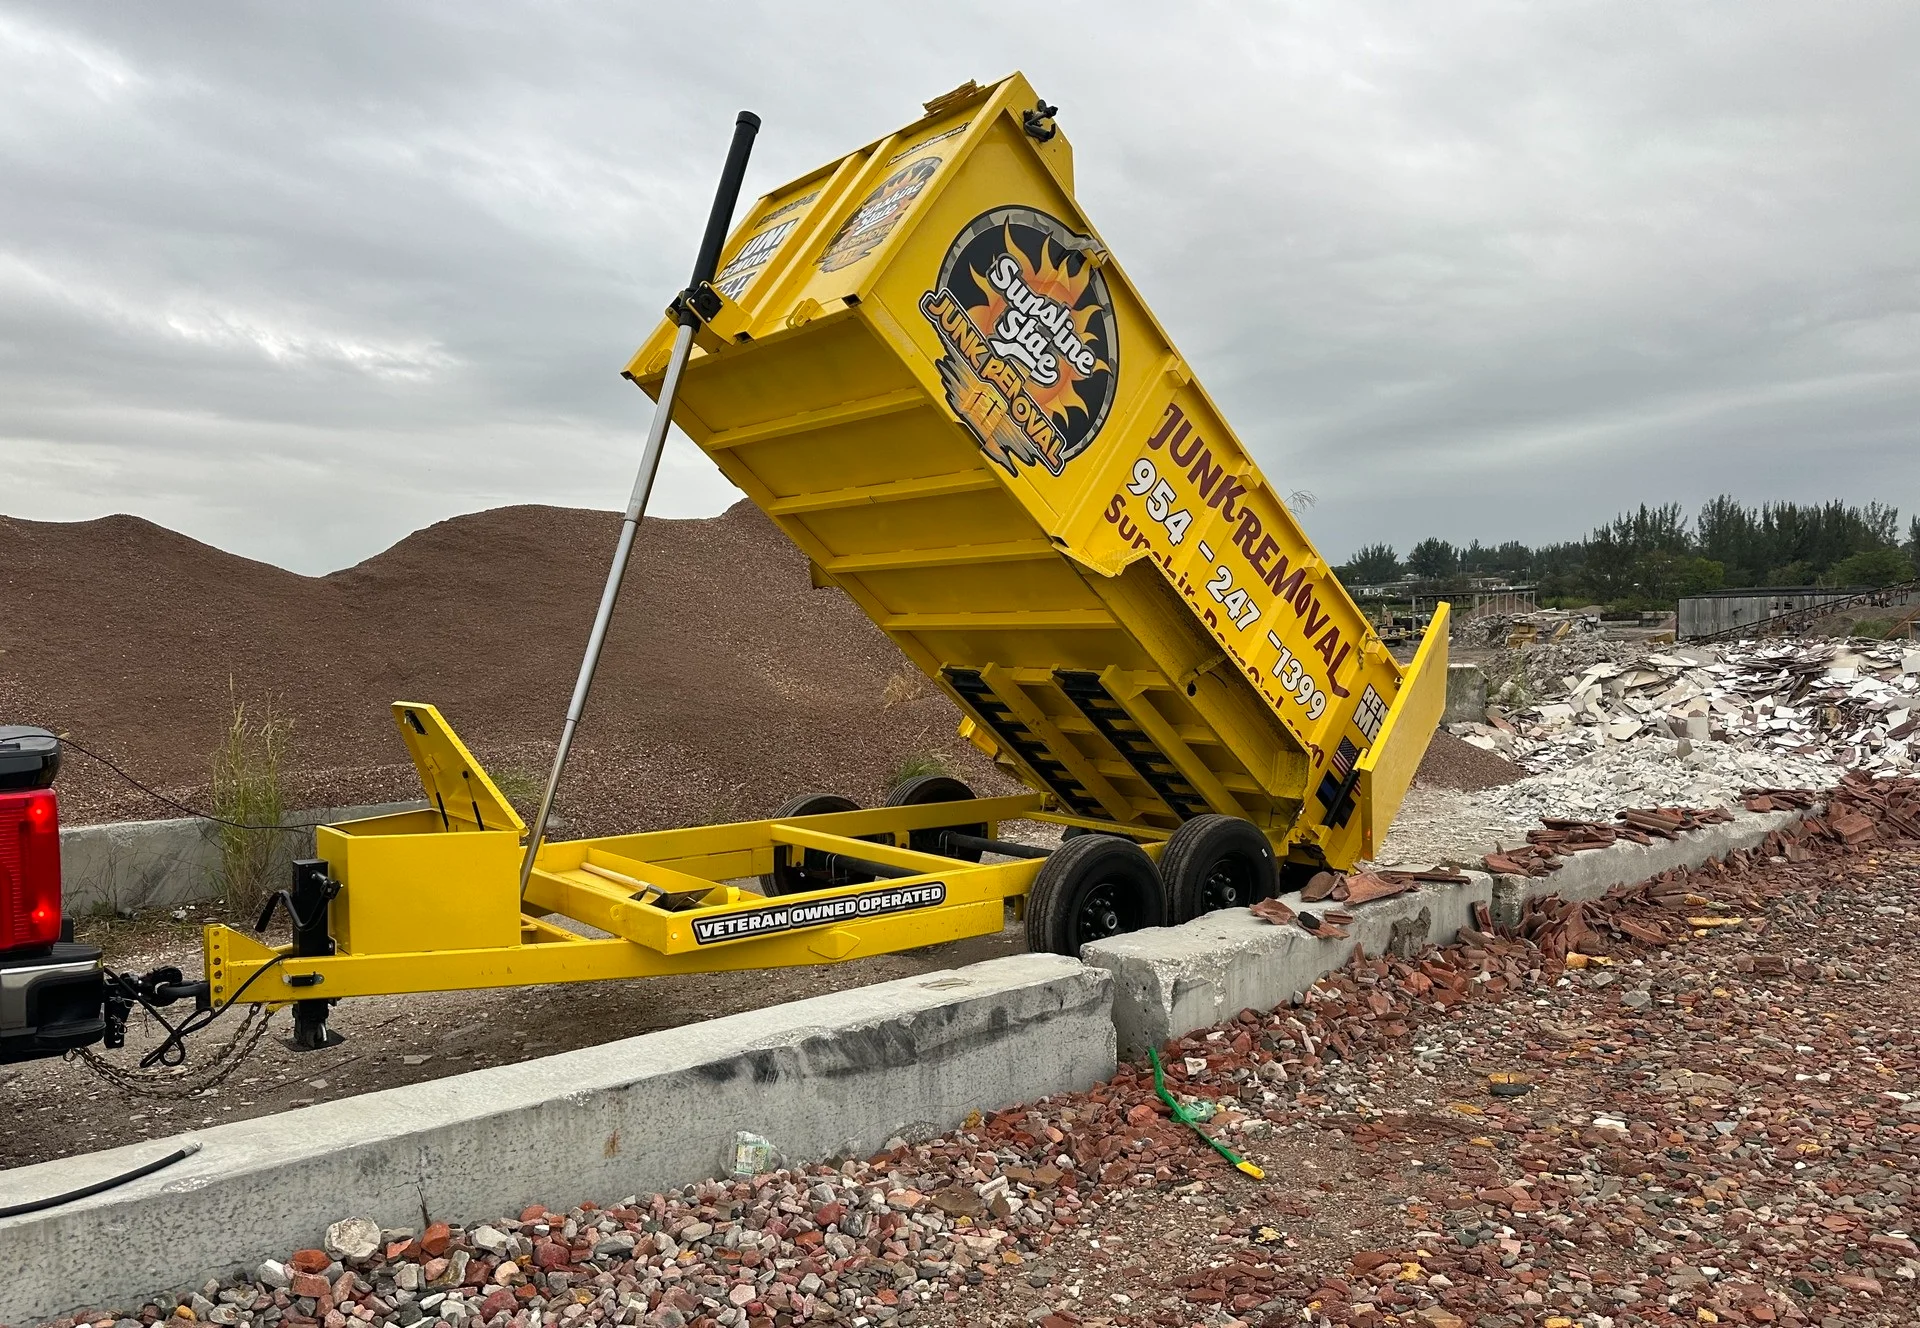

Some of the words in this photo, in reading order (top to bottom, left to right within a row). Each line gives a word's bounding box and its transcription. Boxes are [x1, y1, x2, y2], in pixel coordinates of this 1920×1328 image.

[714, 247, 777, 283] REMOVA
[928, 297, 988, 367] JUNK
[991, 310, 1058, 385] Stae
[1126, 458, 1193, 547] 954
[1205, 565, 1262, 632] 247
[1147, 403, 1247, 522] JUNK
[1232, 506, 1351, 698] REMOVAL
[1362, 684, 1389, 723] REN
[699, 911, 788, 938] VETERAN
[791, 901, 857, 923] OWNED
[858, 887, 942, 912] OPERATED
